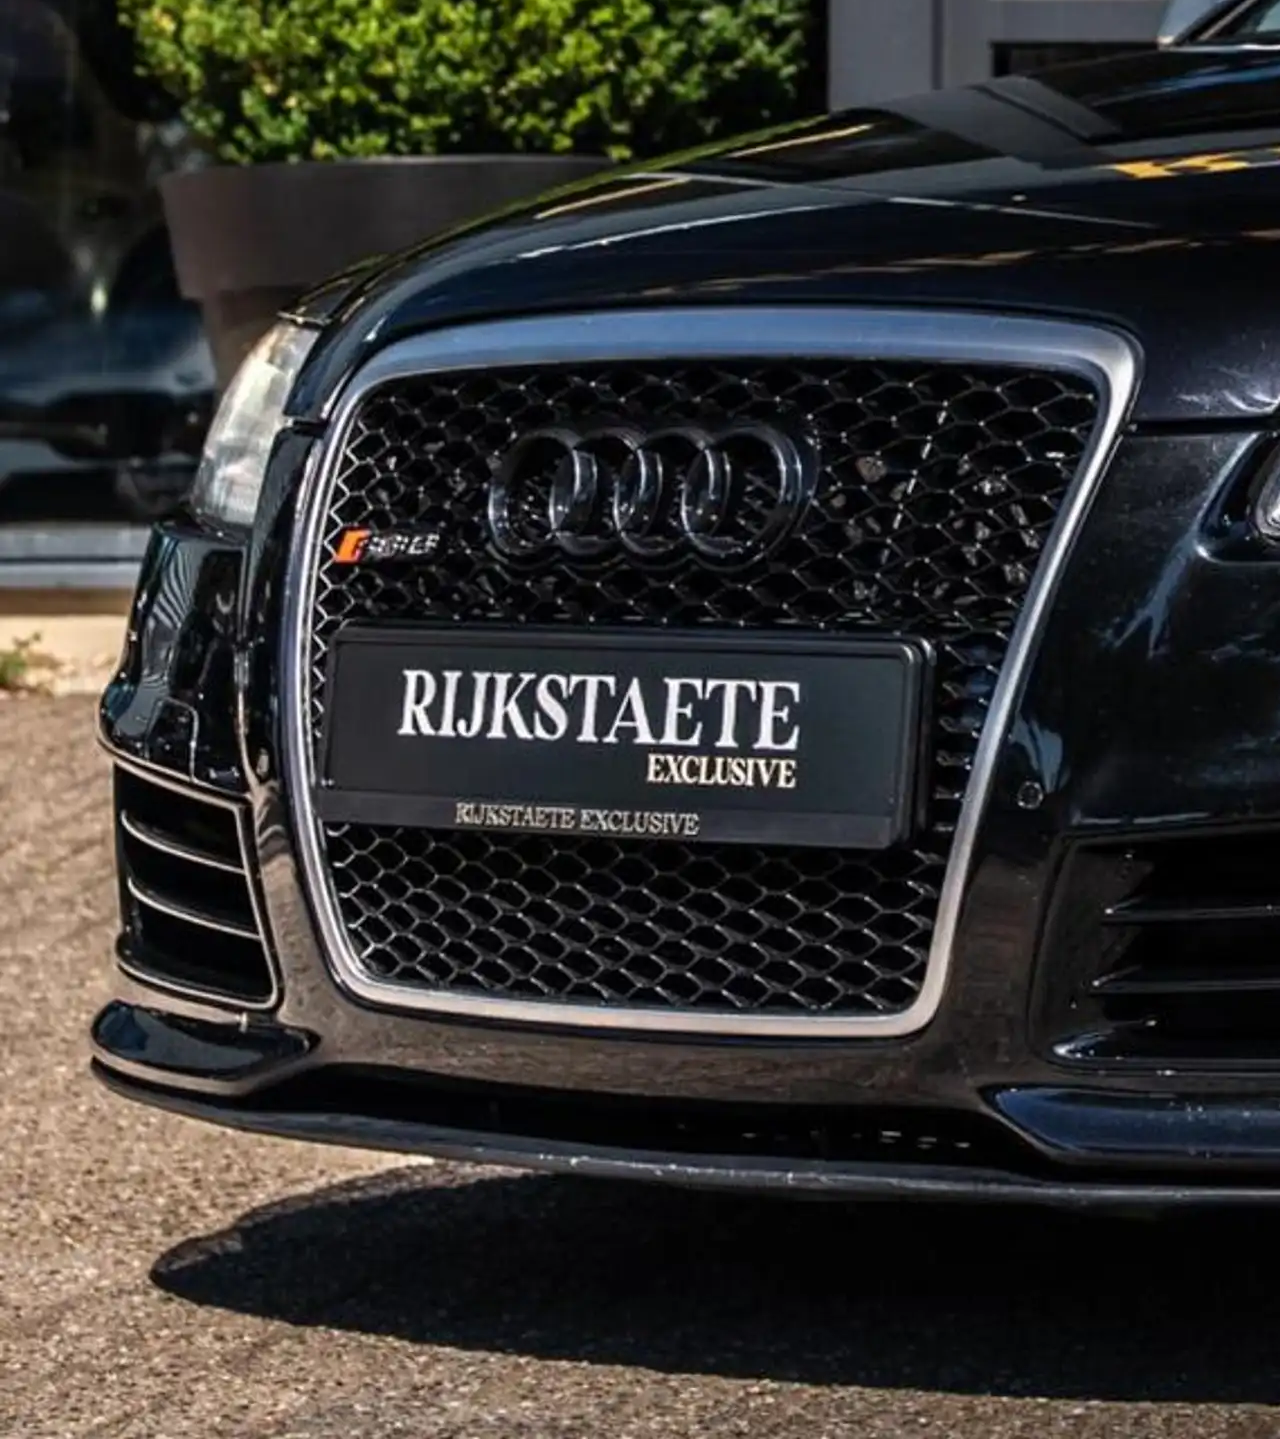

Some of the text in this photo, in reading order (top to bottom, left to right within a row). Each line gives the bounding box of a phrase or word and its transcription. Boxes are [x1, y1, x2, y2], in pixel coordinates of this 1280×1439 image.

[397, 668, 801, 752] RIJKSTAETE
[646, 753, 798, 789] EXCLUSIVE
[455, 802, 701, 837] RIJKSTAETE EXCLUSIVE
